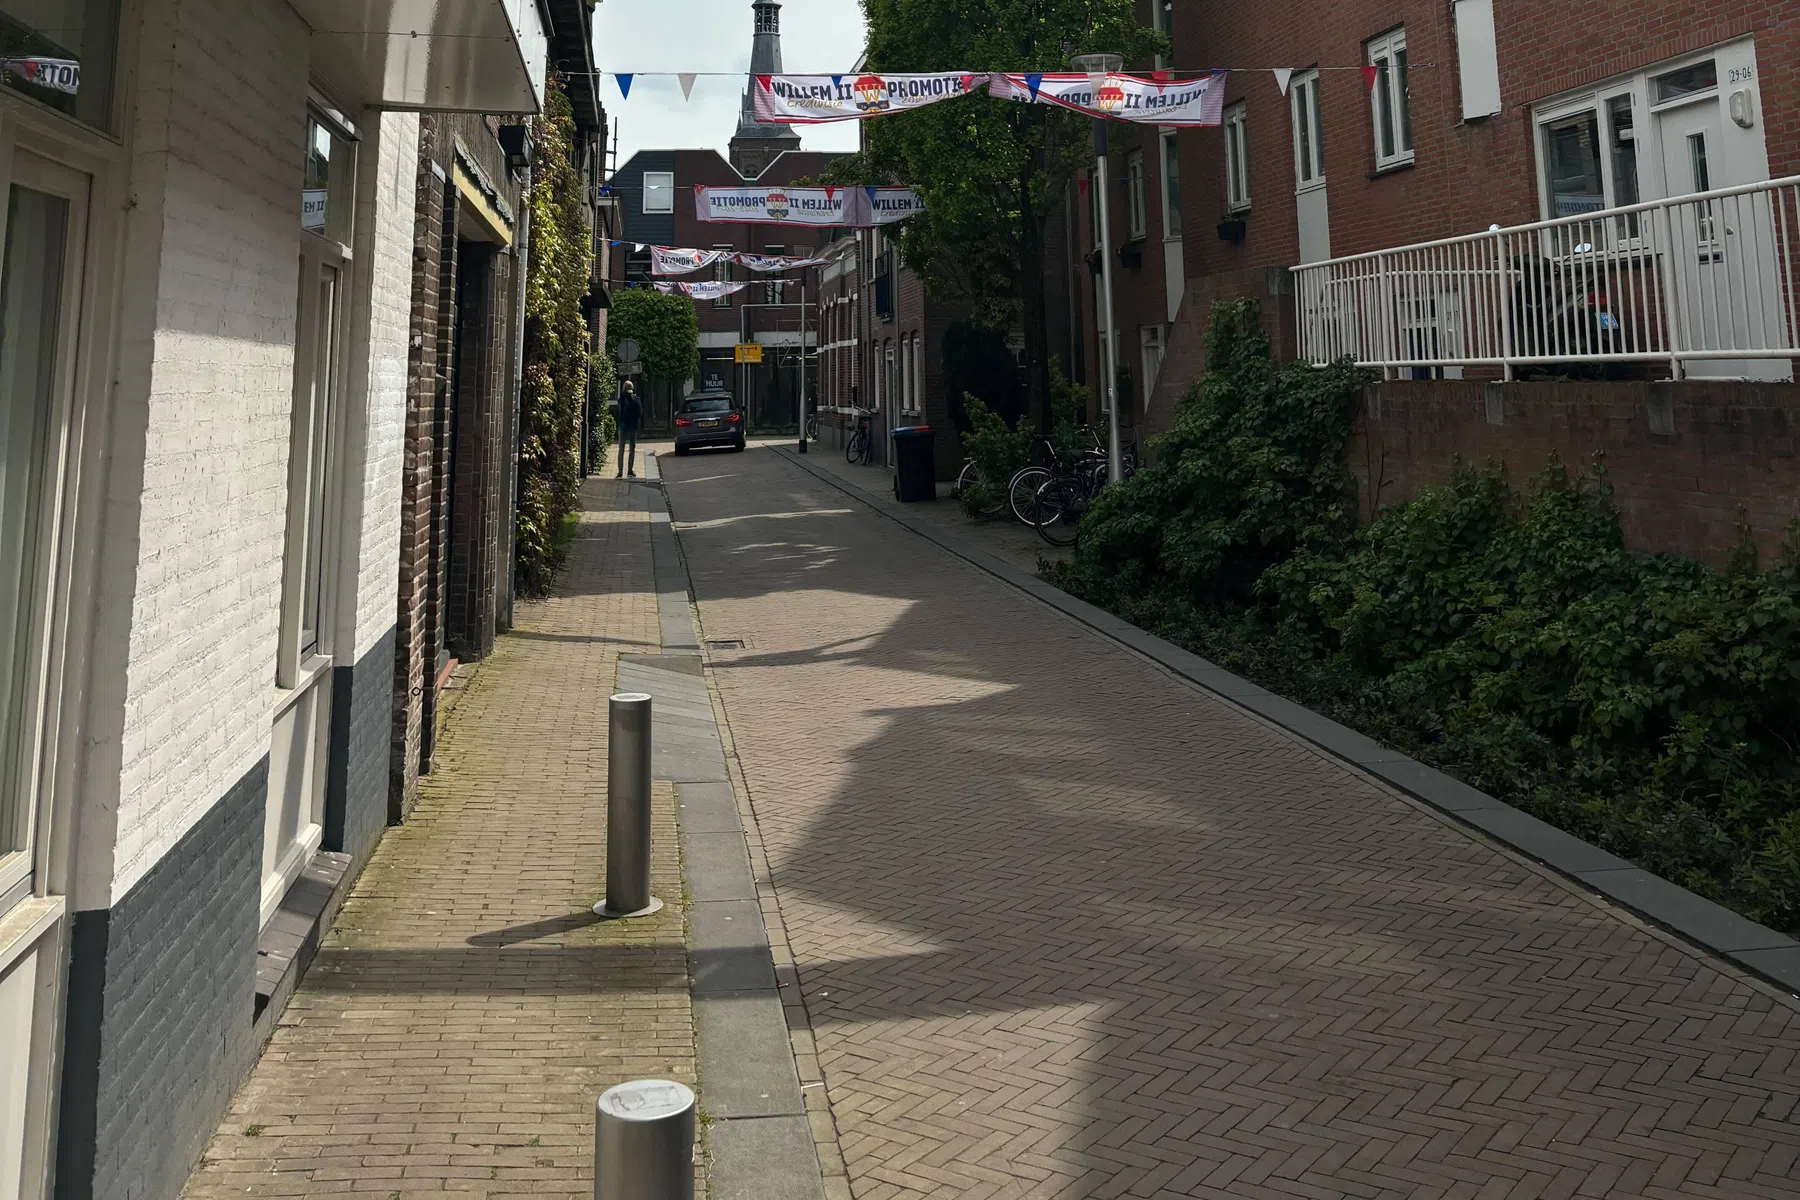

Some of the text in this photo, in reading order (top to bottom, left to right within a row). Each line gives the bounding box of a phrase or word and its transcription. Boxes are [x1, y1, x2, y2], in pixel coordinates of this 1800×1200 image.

[1730, 66, 1752, 82] 29-06
[772, 81, 831, 100] WILLEM
[836, 83, 853, 100] II
[872, 199, 912, 210] WILLEM
